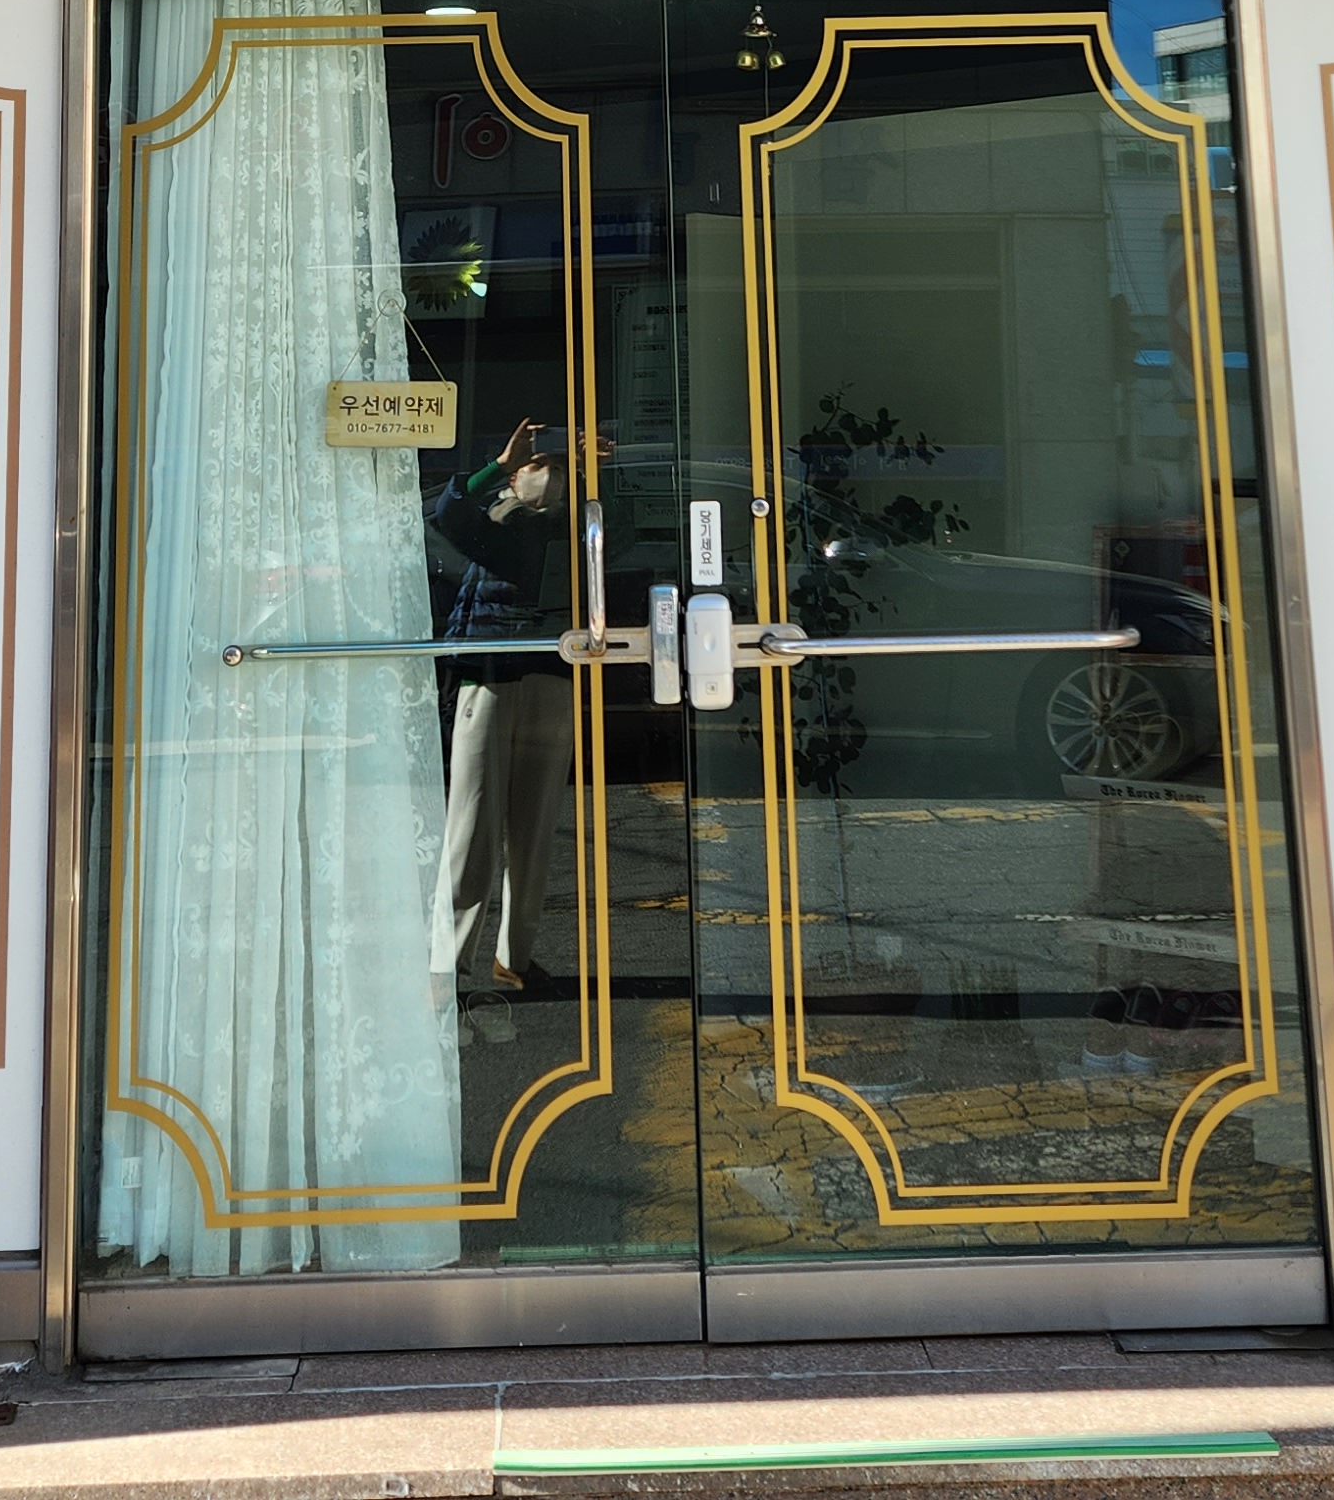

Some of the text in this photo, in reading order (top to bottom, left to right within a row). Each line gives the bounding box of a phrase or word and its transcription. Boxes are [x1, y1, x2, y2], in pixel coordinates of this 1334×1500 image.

[338, 395, 444, 418] 우선예약제
[346, 422, 436, 434] 010-7677-4181
[699, 509, 713, 565] 당기세요
[1099, 783, 1124, 797] The
[1125, 785, 1161, 800] Korea
